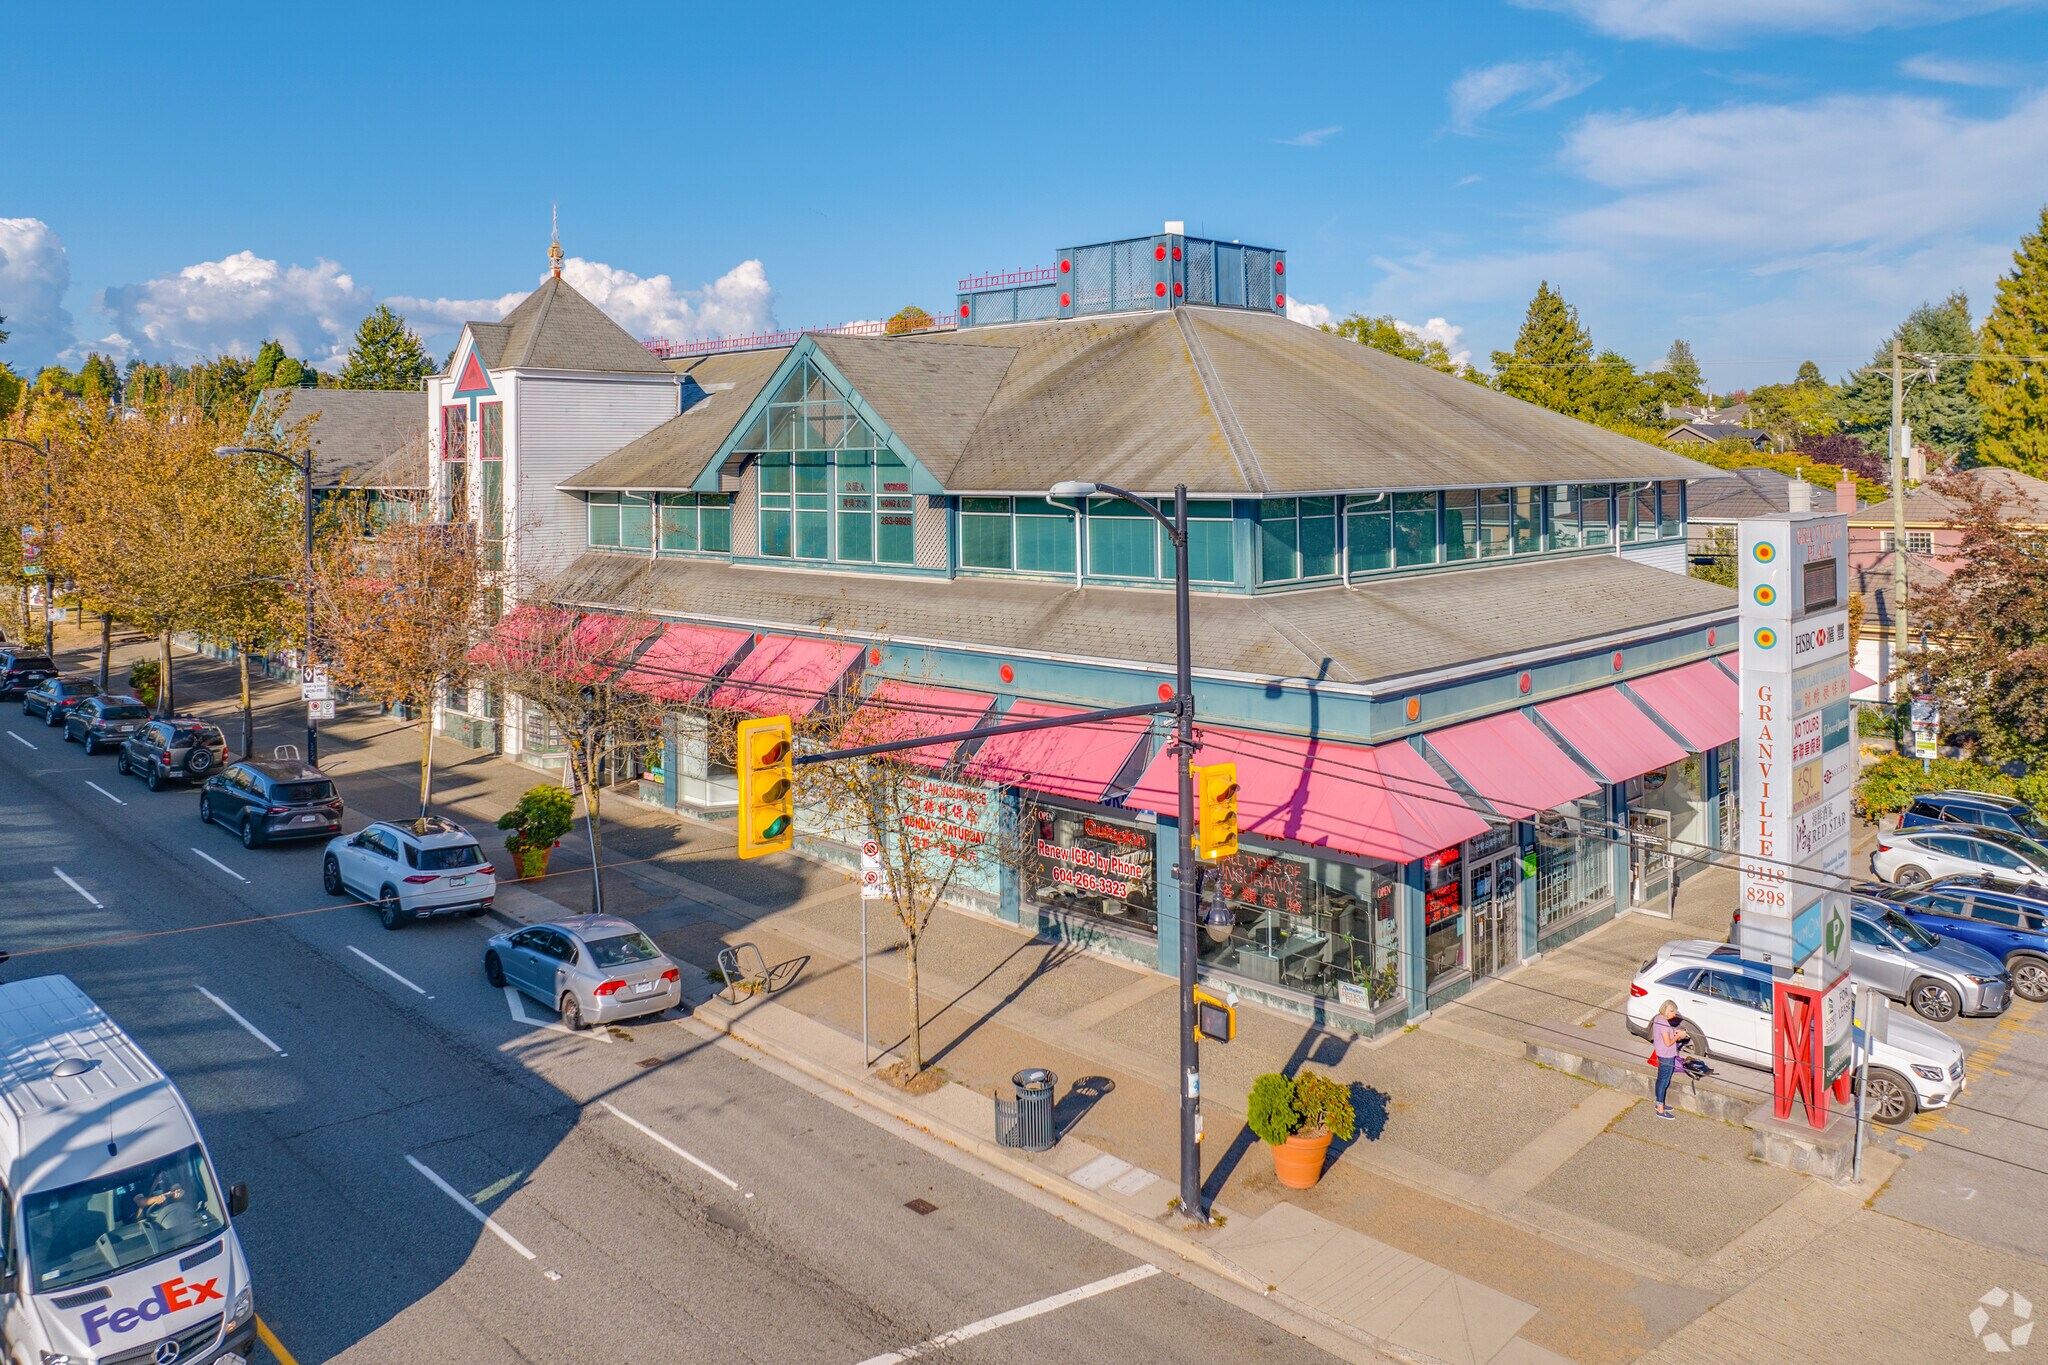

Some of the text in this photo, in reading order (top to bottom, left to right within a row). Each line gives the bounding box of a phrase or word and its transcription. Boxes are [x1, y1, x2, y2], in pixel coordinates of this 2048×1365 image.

[1807, 541, 1832, 562] PLACE
[1795, 631, 1816, 654] HSBC
[1802, 715, 1819, 736] TOURS
[1758, 685, 1773, 857] GRANVILLE
[924, 782, 938, 795] LAU
[1038, 810, 1055, 822] OPEN
[1812, 811, 1846, 844] RED STAR
[1038, 839, 1142, 878] Renew ICBC by Phone
[1223, 855, 1302, 878] ALL TYPES OF
[1053, 866, 1127, 898] 604-266-3323
[1221, 865, 1303, 899] INSURANCE
[1746, 864, 1785, 884] 8118
[1377, 885, 1392, 899] OPEN
[1746, 887, 1785, 907] 8298
[1839, 987, 1849, 1002] FOR
[1838, 999, 1851, 1020] LEASE
[81, 1277, 225, 1347] FedEx
